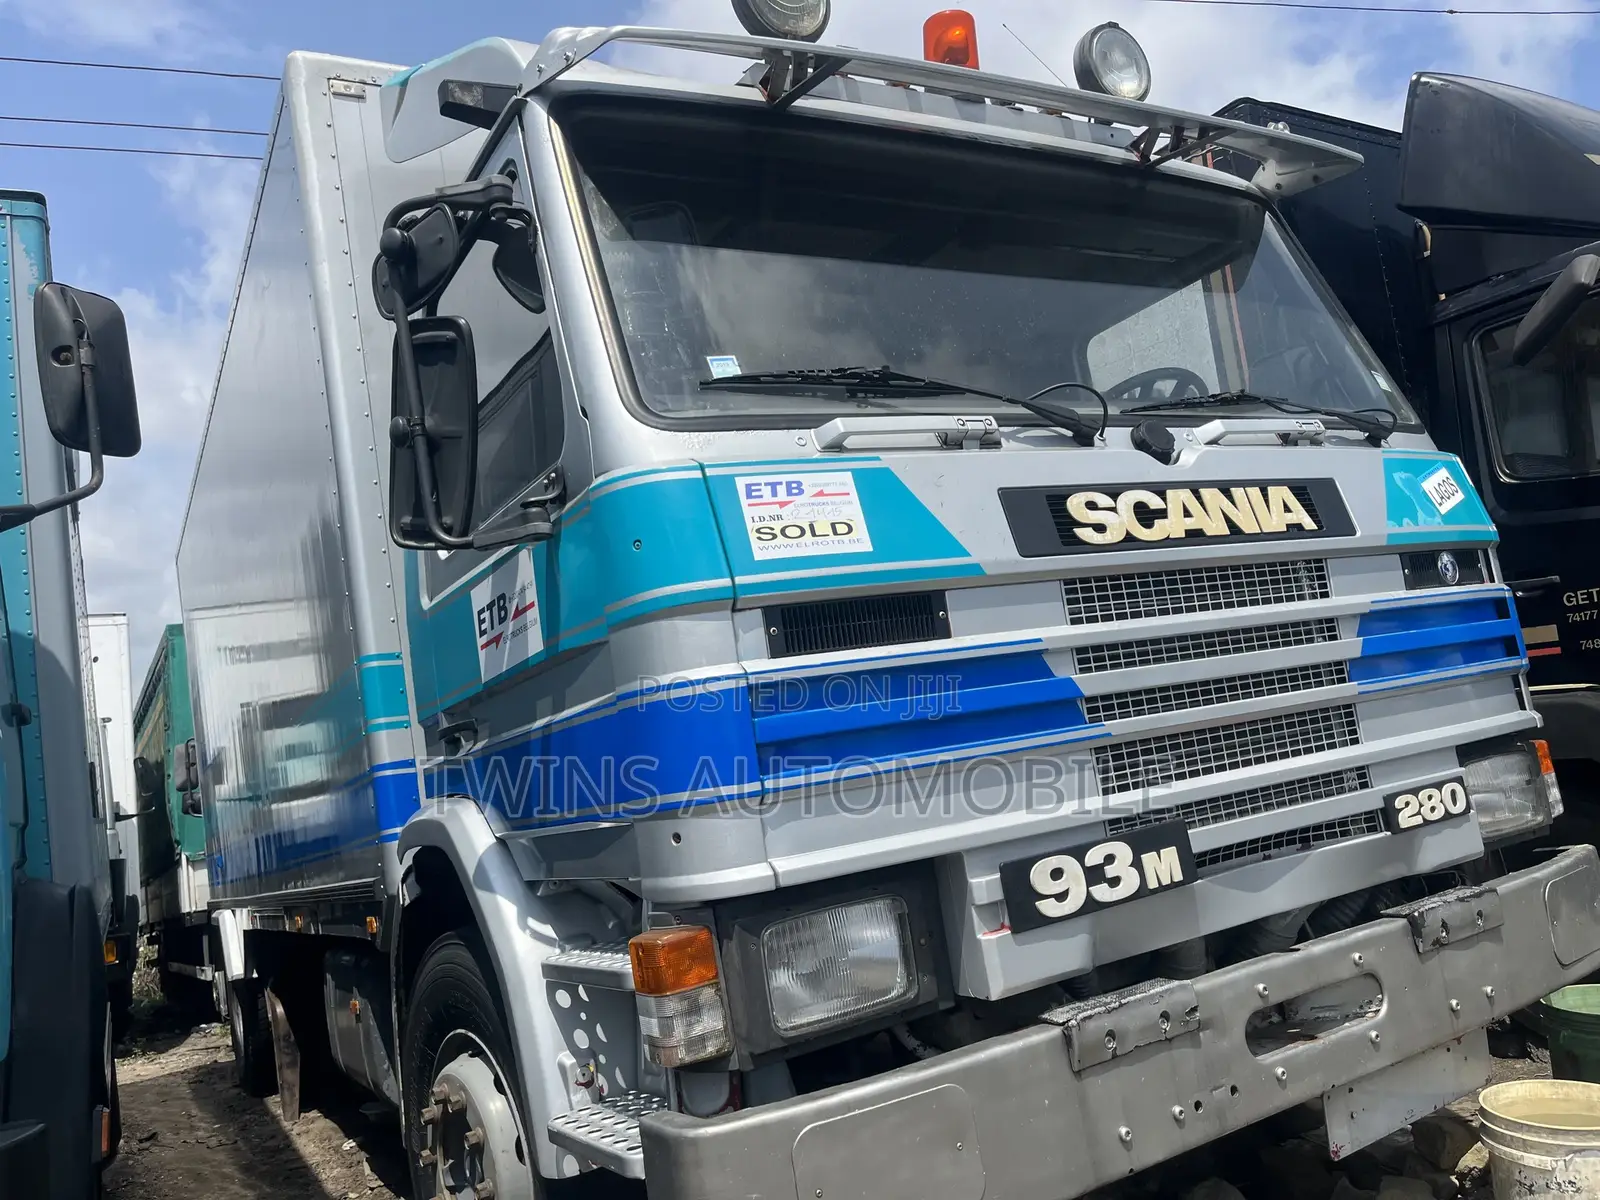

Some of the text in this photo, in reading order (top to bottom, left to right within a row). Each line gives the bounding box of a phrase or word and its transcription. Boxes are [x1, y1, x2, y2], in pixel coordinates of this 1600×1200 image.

[744, 480, 805, 500] ETB
[1427, 476, 1459, 507] LAGOS
[751, 513, 784, 523] I.D.NR
[1066, 486, 1318, 545] SCANIA
[754, 520, 854, 542] SOLD
[477, 592, 508, 638] ETB
[1566, 610, 1598, 624] 74177
[1579, 638, 1600, 651] 748
[1394, 781, 1467, 829] 280
